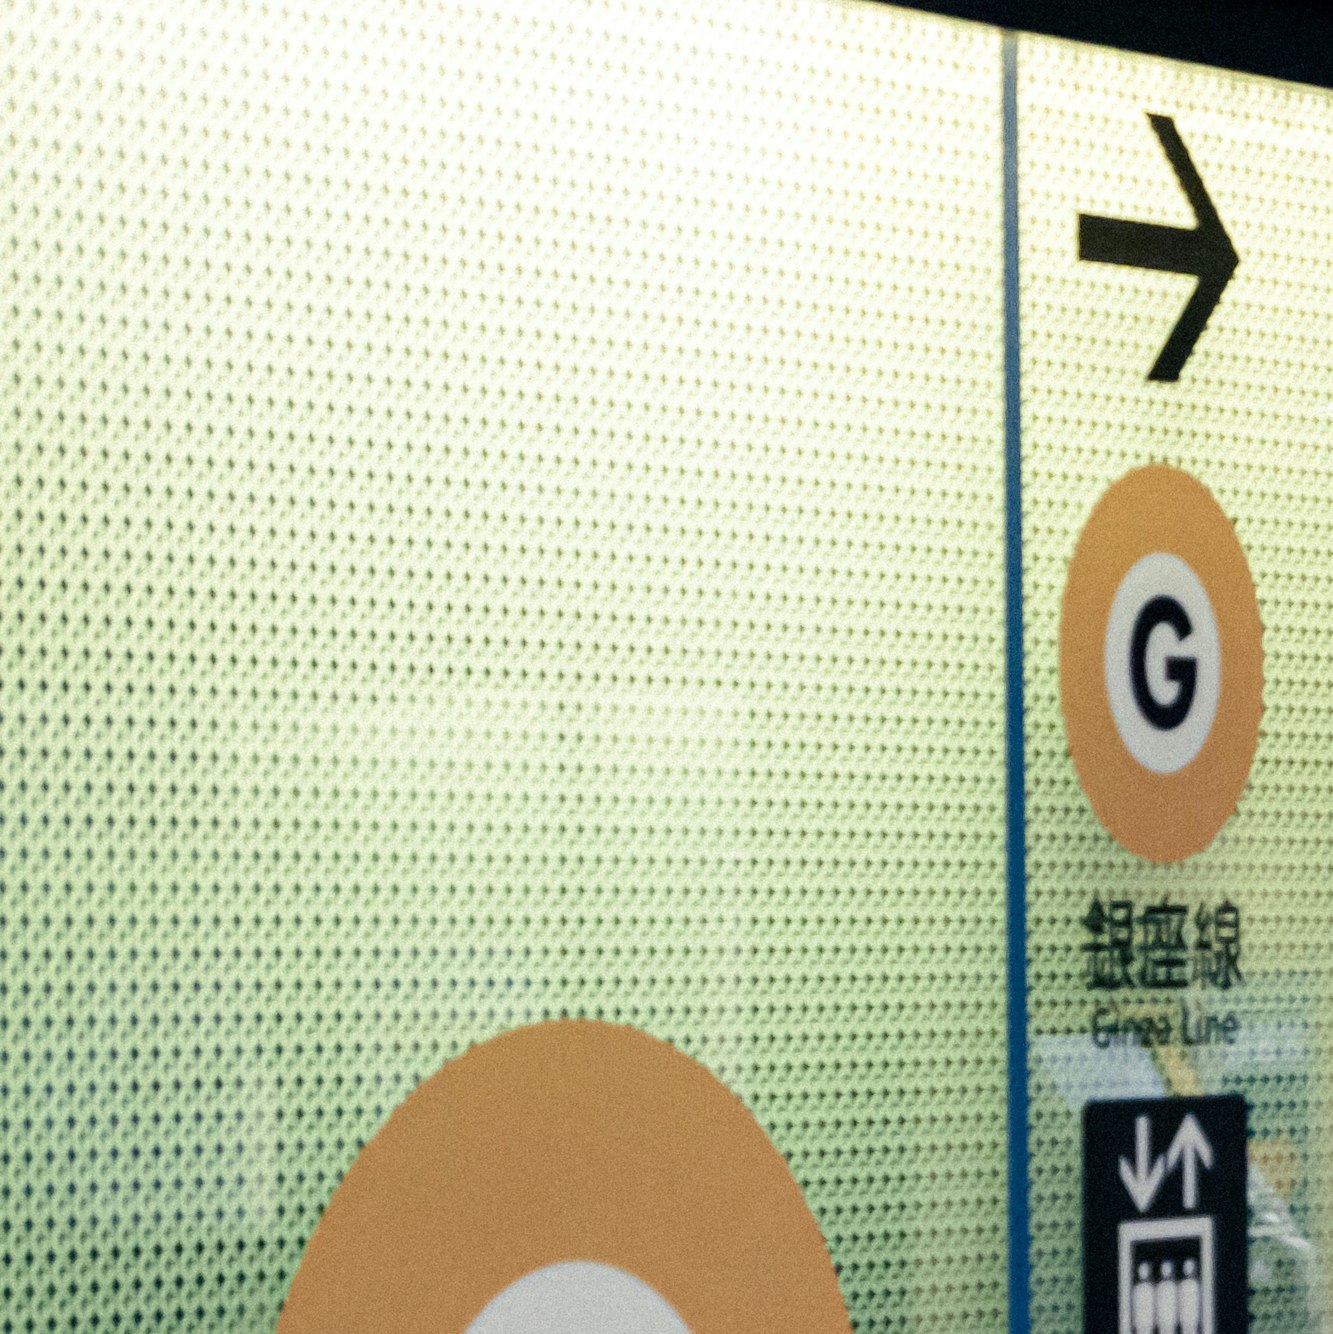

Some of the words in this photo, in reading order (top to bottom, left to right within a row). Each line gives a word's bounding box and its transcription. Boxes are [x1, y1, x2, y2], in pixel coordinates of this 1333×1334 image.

[1130, 594, 1198, 731] G
[1082, 898, 1243, 989] 銀座線
